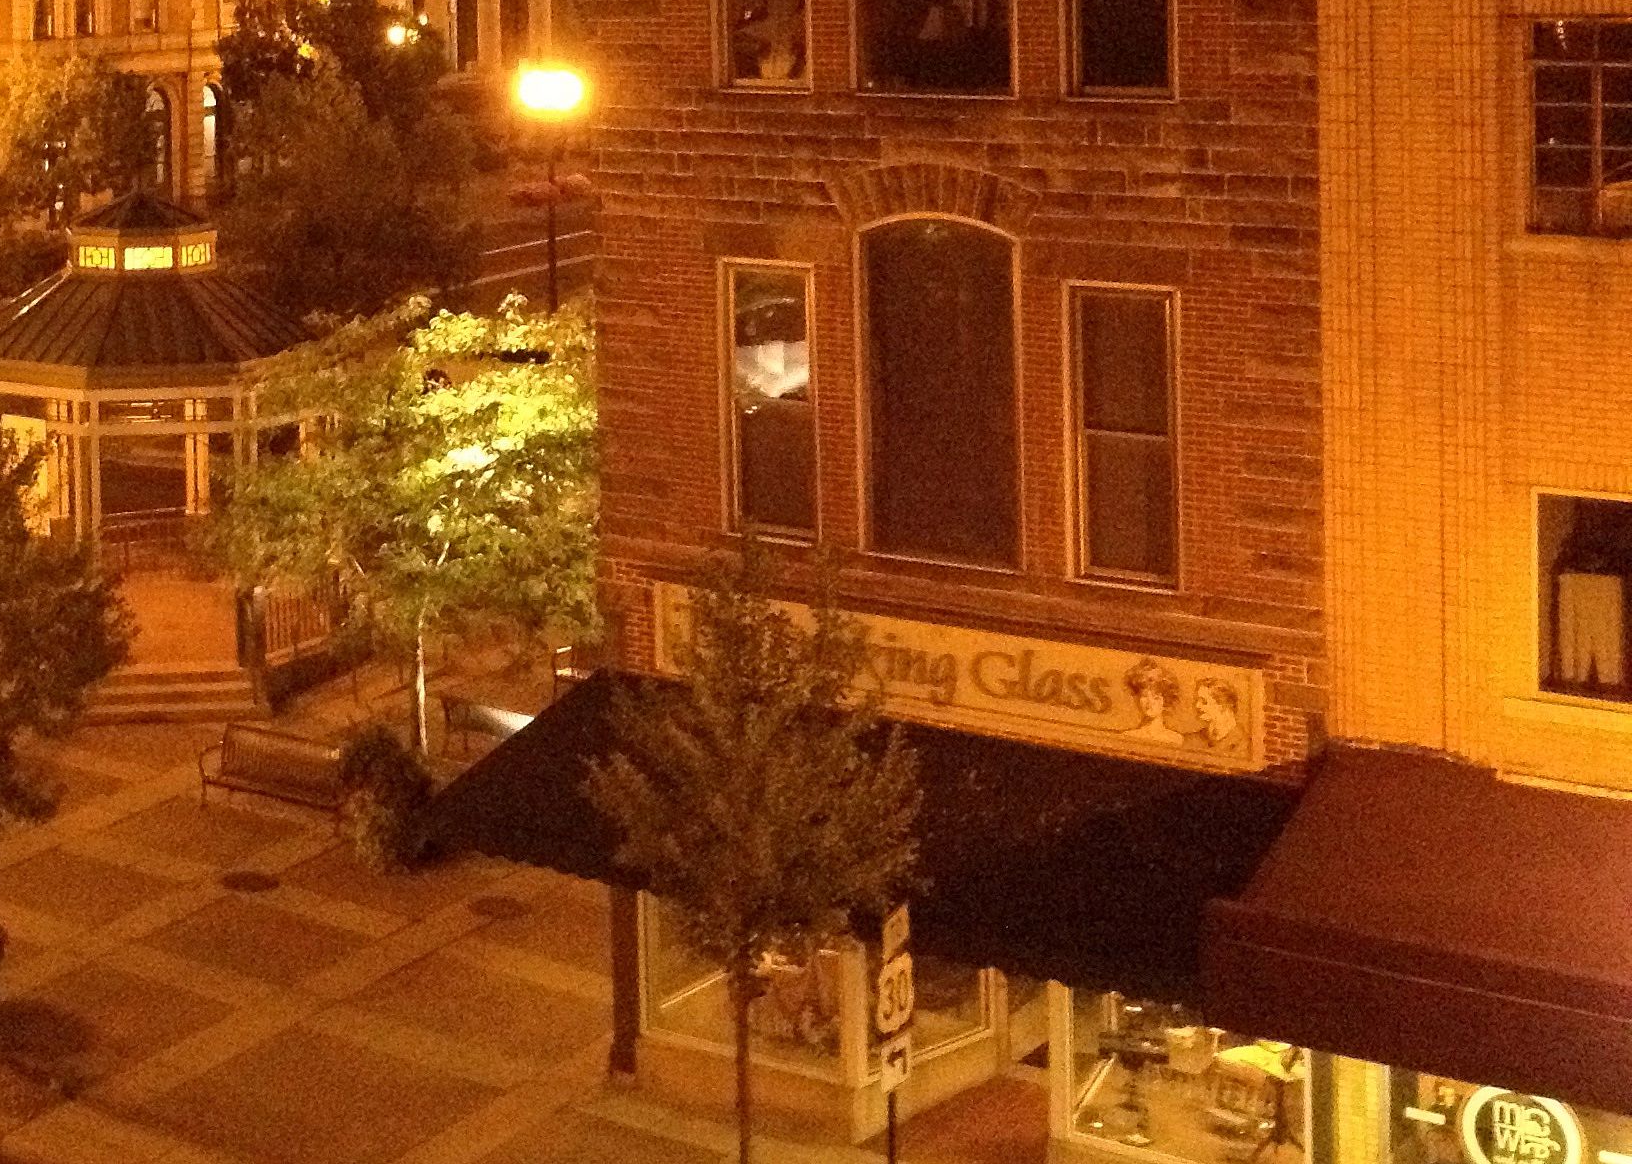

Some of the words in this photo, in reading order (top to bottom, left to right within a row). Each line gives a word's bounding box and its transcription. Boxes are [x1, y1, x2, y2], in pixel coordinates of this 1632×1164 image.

[870, 631, 959, 706] ing
[969, 649, 1113, 715] Glass
[882, 969, 908, 1021] 30
